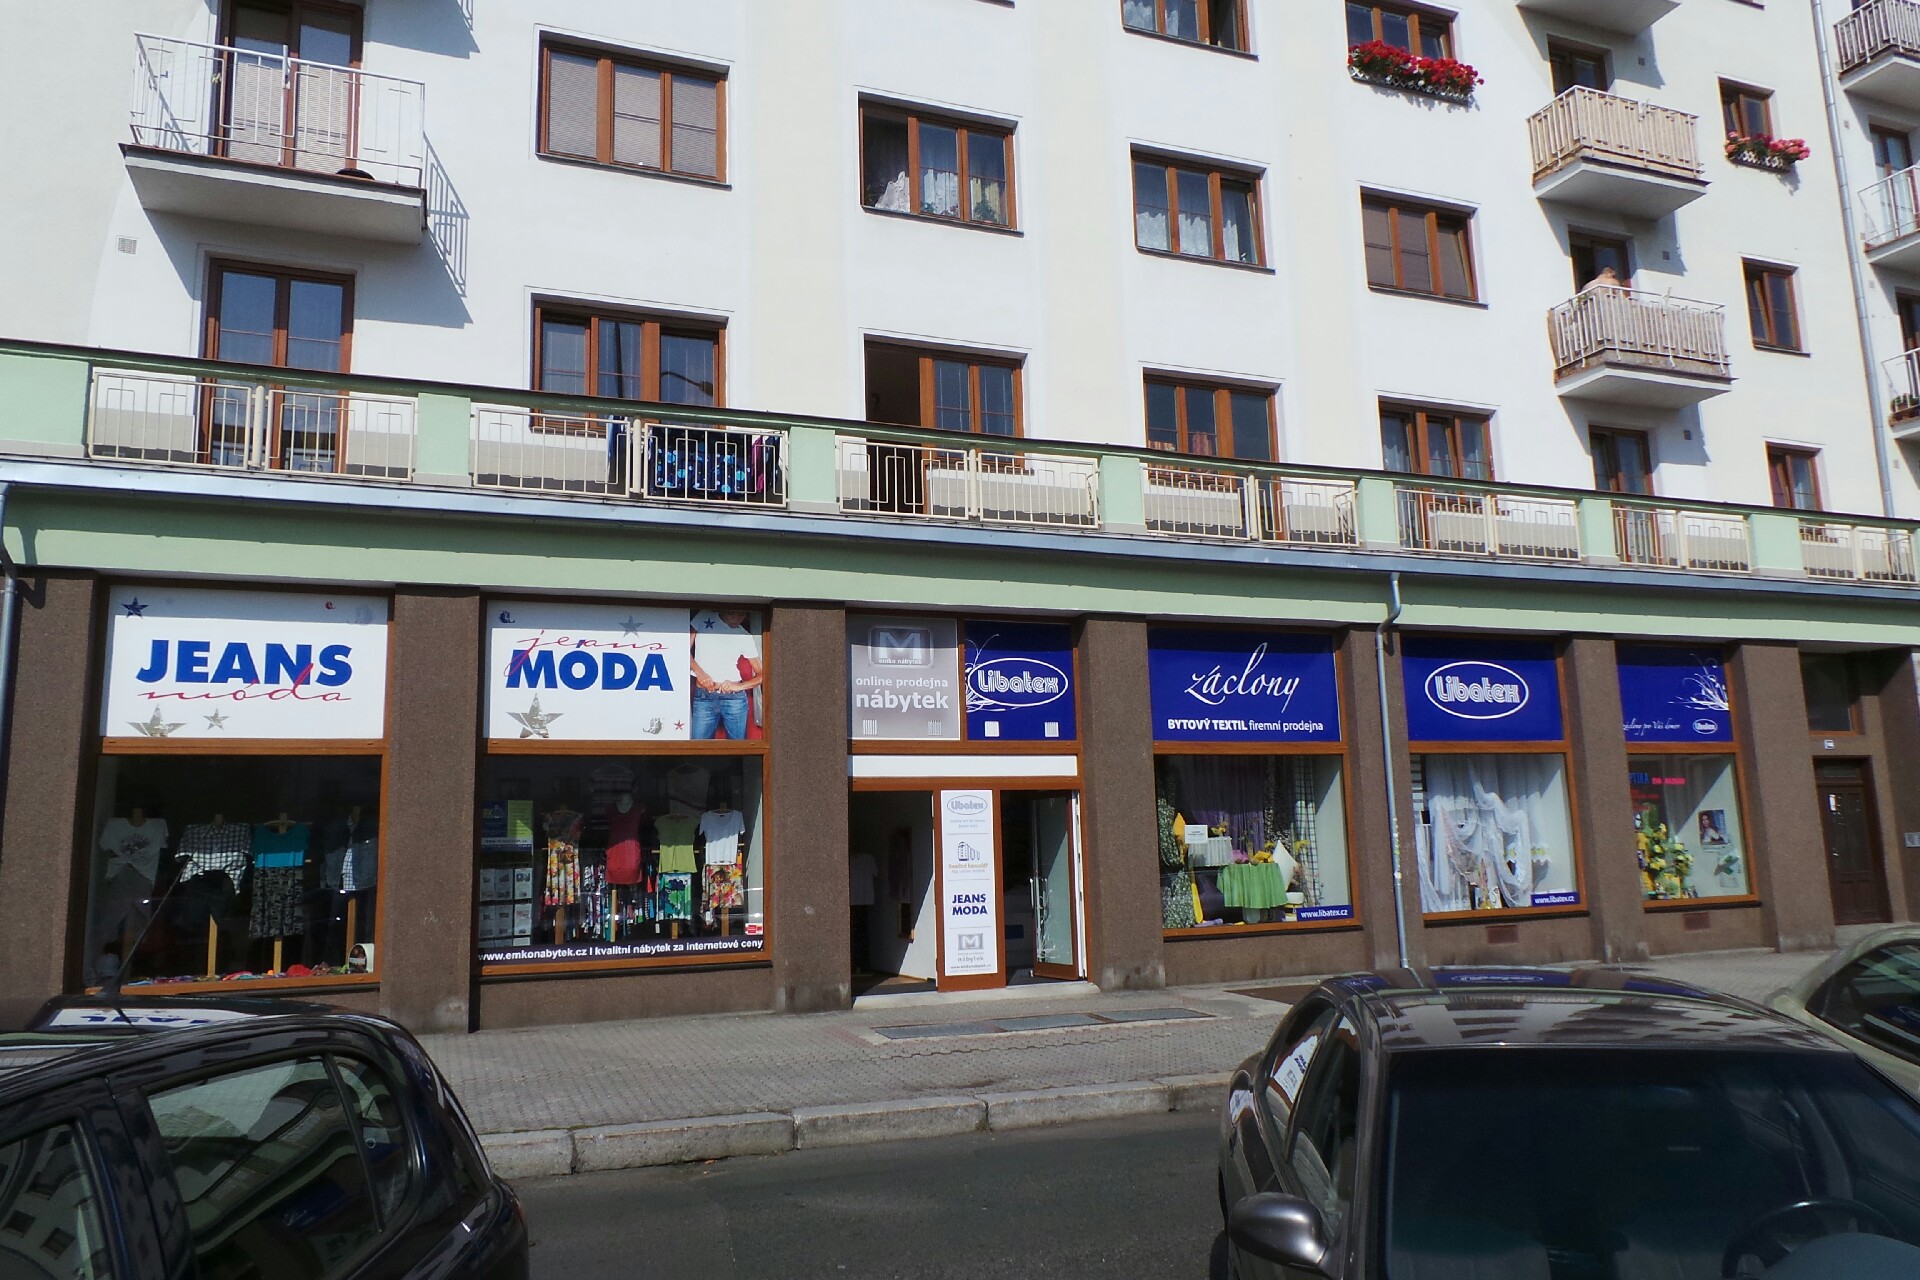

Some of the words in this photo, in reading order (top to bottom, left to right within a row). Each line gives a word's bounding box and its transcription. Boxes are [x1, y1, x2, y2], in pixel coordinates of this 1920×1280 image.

[135, 639, 353, 687] JEANS
[503, 629, 669, 678] jeans
[855, 676, 893, 687] online
[896, 677, 948, 689] prodejna
[977, 670, 1059, 693] Libatex
[1184, 642, 1300, 713] záclony
[1435, 675, 1520, 703] Libatex
[856, 690, 949, 713] nábytek
[1167, 718, 1210, 730] BYTOVÝ
[1212, 719, 1248, 731] TEXTIL
[1249, 720, 1281, 731] firemní
[1283, 720, 1324, 733] prodejna
[952, 893, 986, 904] JEANS
[952, 905, 988, 916] MODA
[1300, 908, 1348, 918] www.libatex.cz
[478, 948, 587, 961] www.emkonabytek.cz
[595, 943, 631, 956] kvalitní
[633, 942, 671, 954] nábytek
[672, 943, 684, 952] za
[686, 939, 739, 951] internetové
[740, 940, 763, 949] ceny
